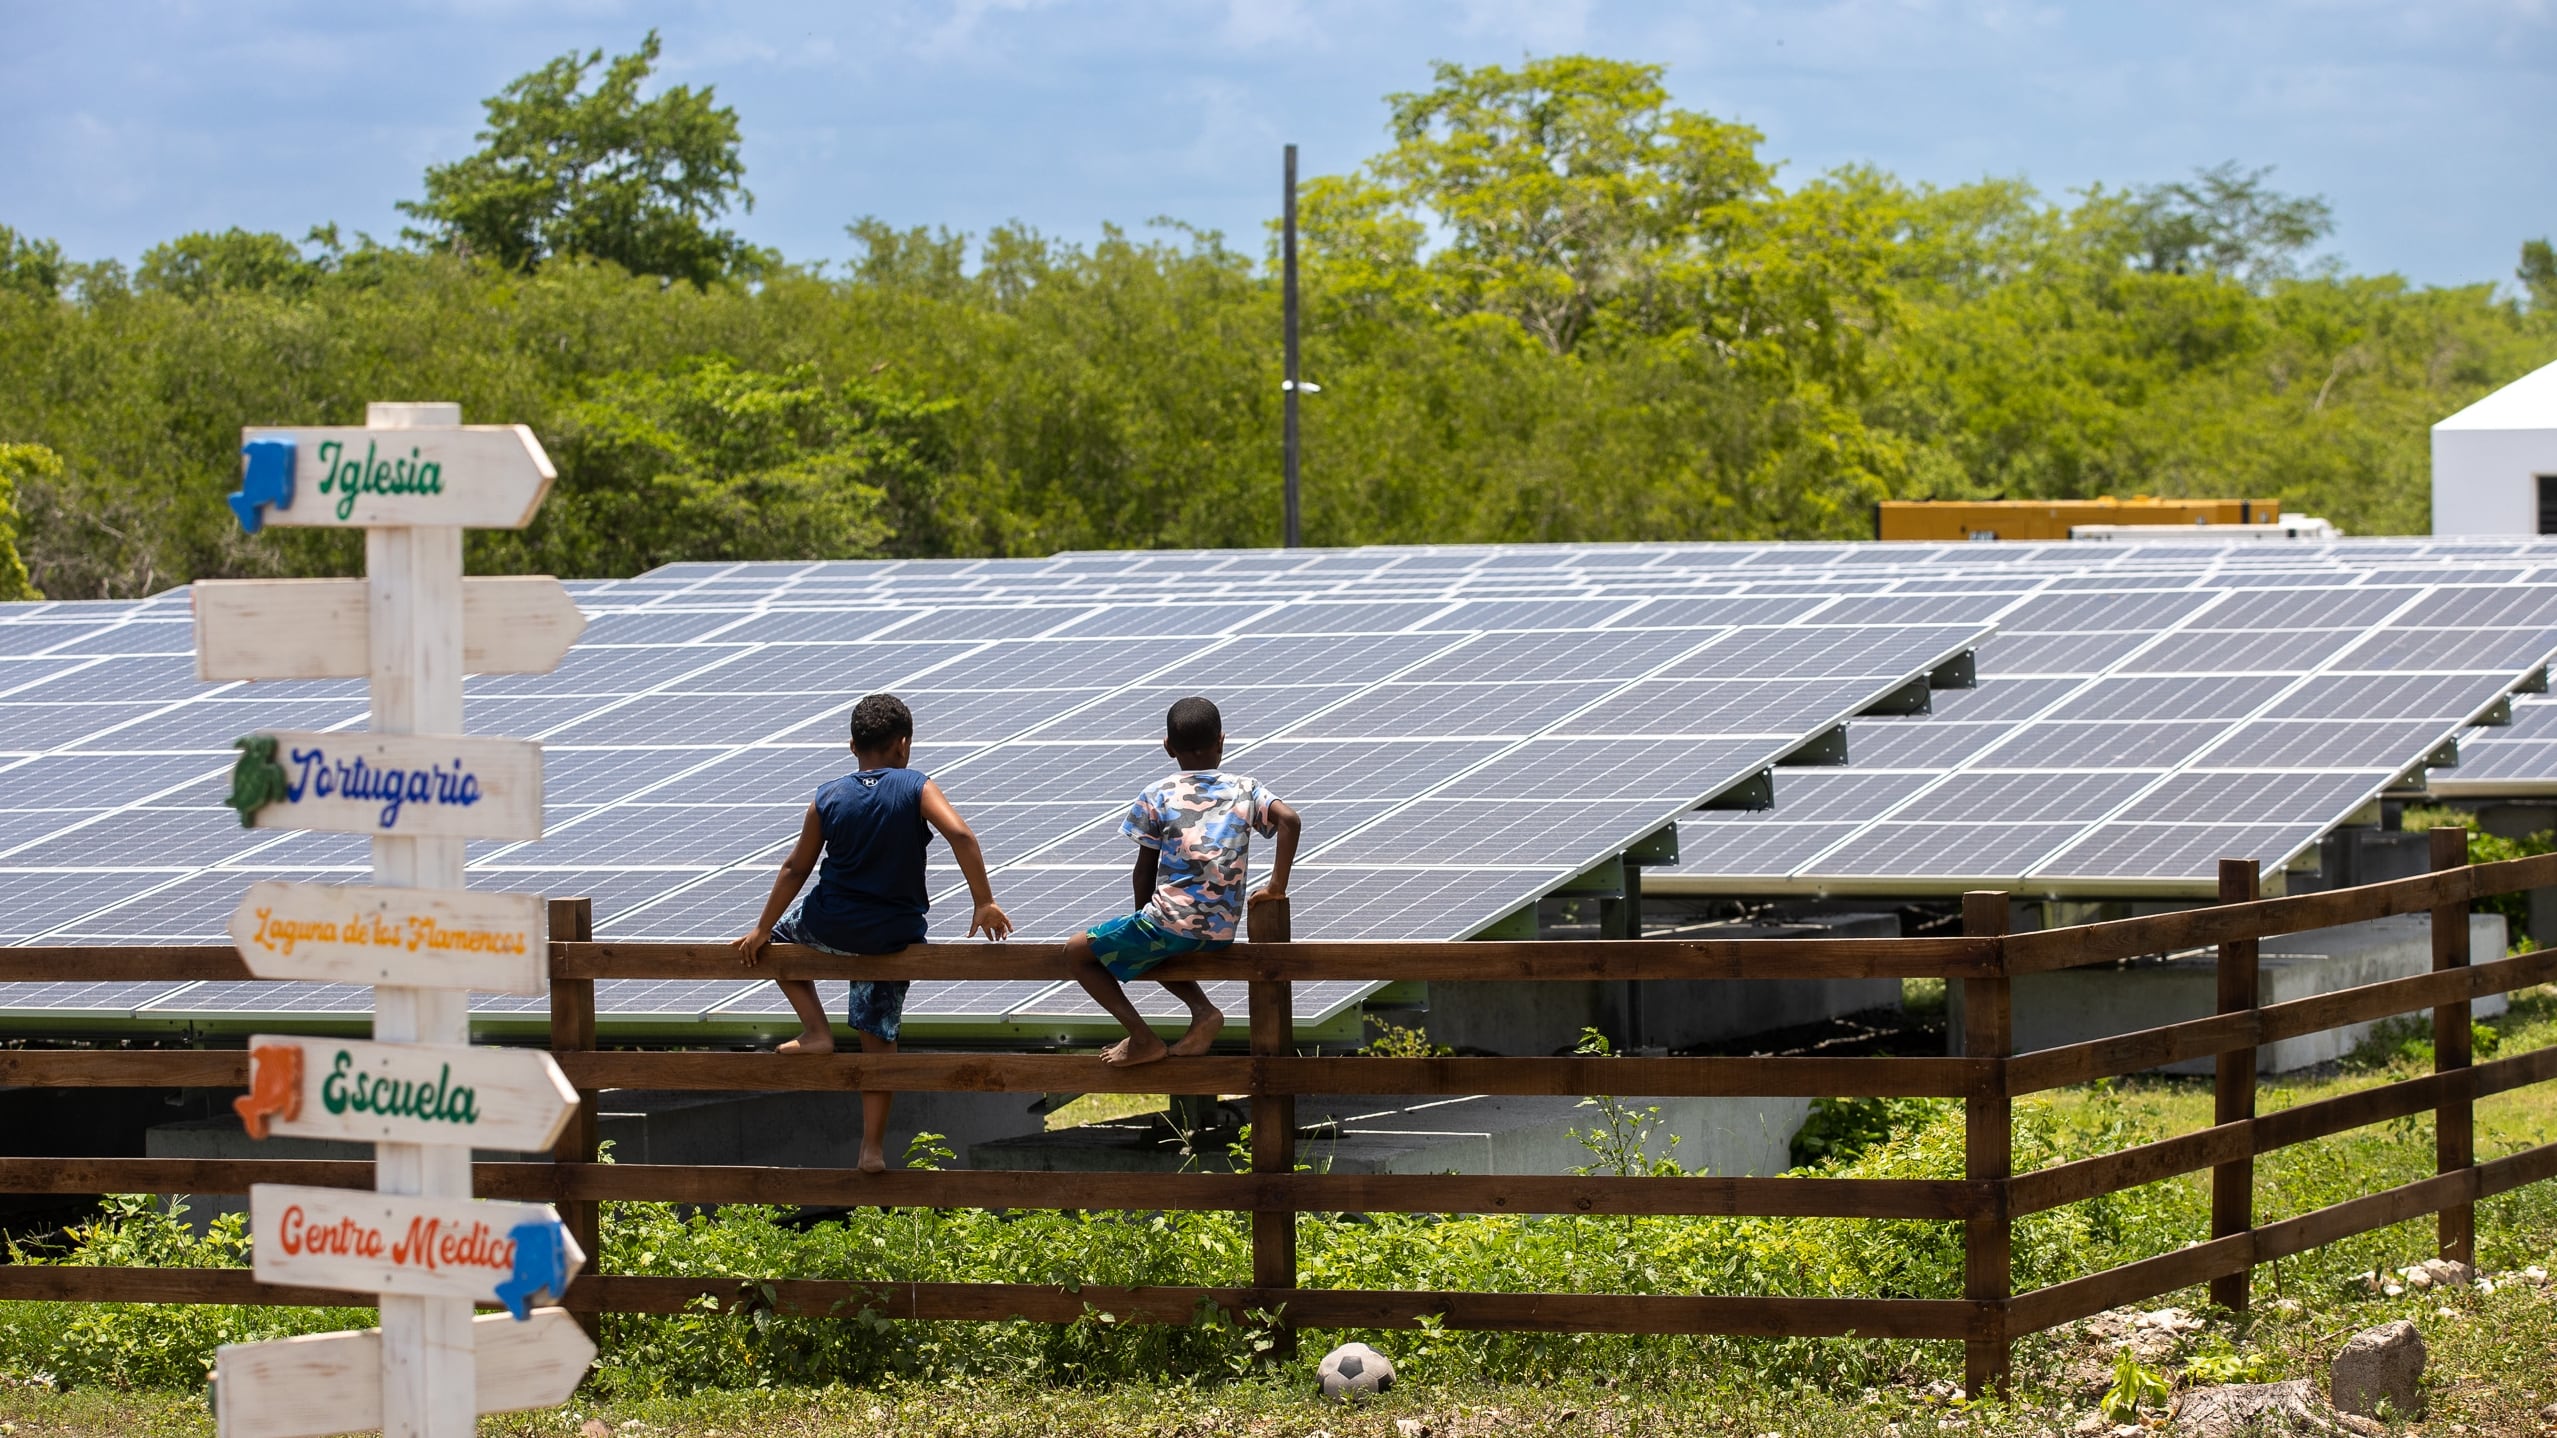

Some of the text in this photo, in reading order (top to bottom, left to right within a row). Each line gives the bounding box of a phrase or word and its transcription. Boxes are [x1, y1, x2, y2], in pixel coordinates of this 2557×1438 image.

[318, 438, 444, 520] Iglesia
[287, 748, 481, 829] Tortugario
[253, 906, 526, 956] Laguna de los Flamencos
[322, 1049, 480, 1125] Escuela
[280, 1204, 384, 1257] Centro
